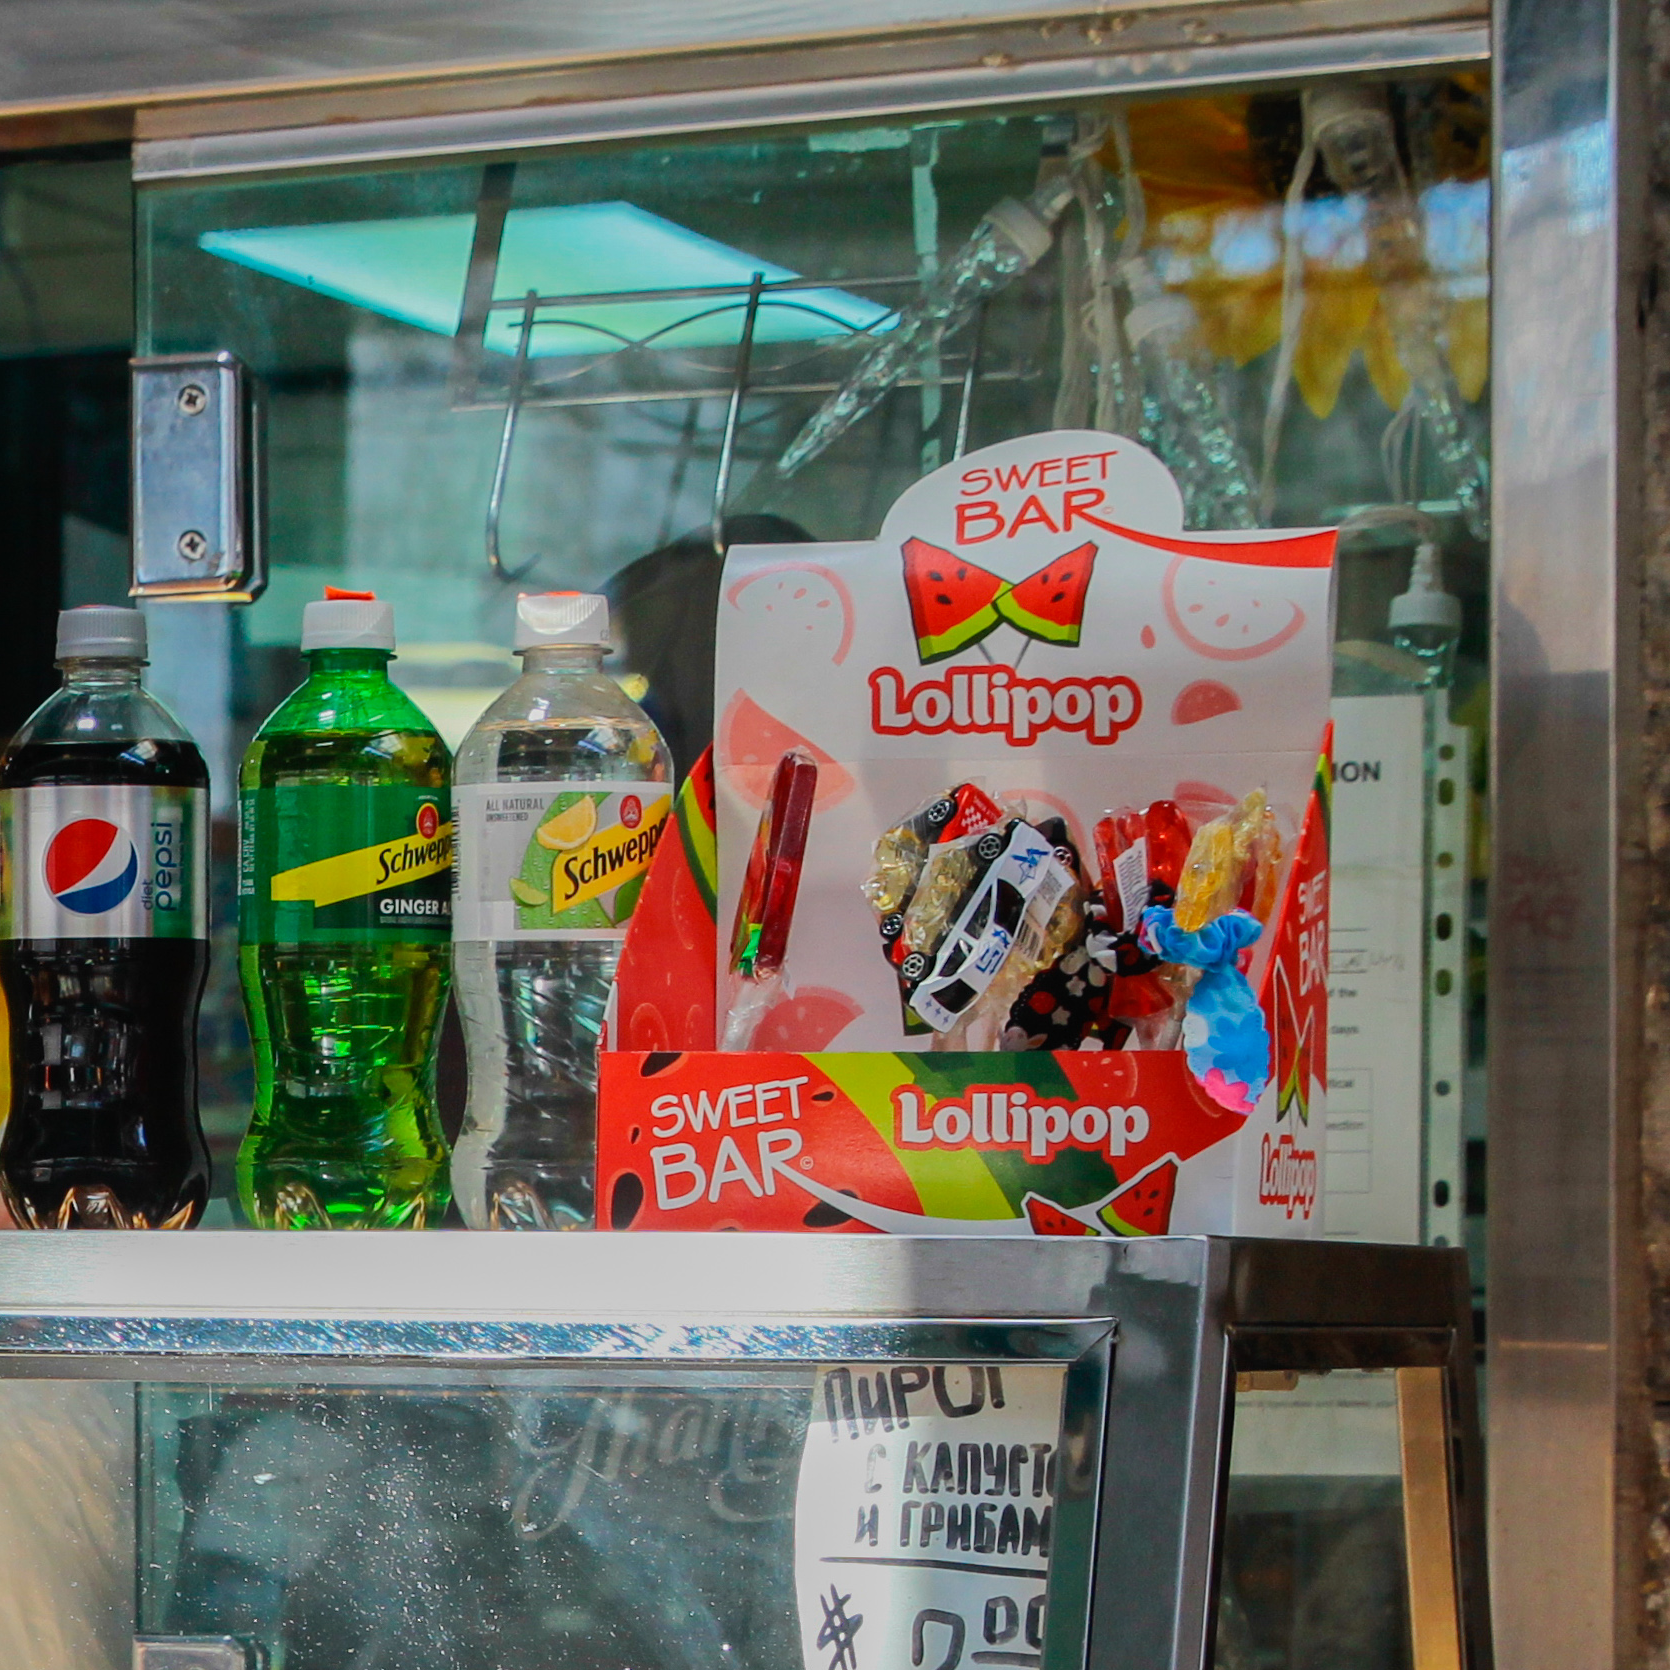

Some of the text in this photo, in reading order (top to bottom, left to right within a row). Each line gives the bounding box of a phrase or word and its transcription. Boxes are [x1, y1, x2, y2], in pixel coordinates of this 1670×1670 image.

[961, 451, 1118, 496] SWEET
[956, 488, 1107, 546] BAR
[868, 667, 1143, 747] Lollipop
[142, 880, 153, 910] diet
[151, 822, 177, 911] pepsi
[380, 899, 439, 915] GINGER
[650, 1076, 809, 1139] SWEET
[897, 1090, 1151, 1158] Lollipop
[650, 1128, 803, 1211] BAR
